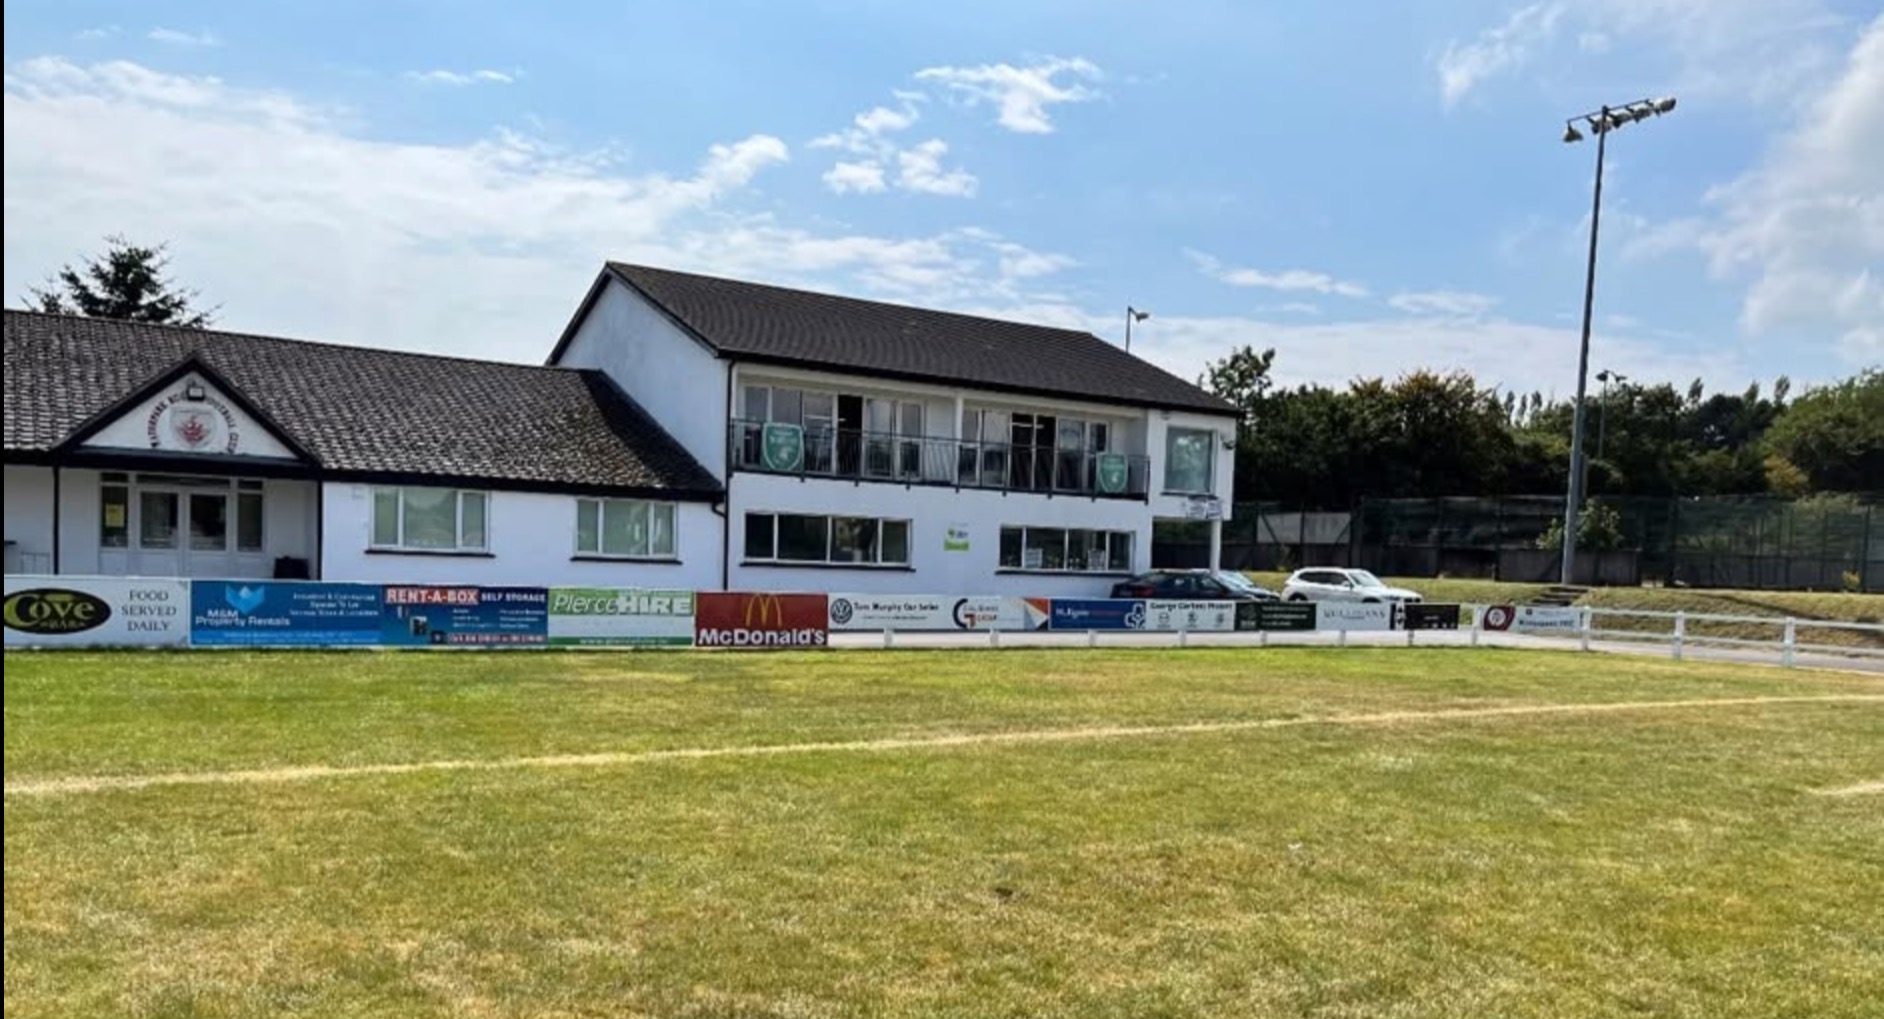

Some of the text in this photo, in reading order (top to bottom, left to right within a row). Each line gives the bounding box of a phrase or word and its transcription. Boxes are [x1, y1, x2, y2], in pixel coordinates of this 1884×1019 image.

[129, 590, 169, 601] FOOD
[387, 589, 478, 605] RENT-A-BOX
[481, 593, 545, 603] SELF STORAGE
[4, 593, 96, 627] Cove
[122, 604, 176, 616] SERVED
[207, 609, 239, 618] M&M
[873, 603, 901, 614] Murphy
[127, 620, 169, 632] DAILY
[195, 616, 291, 627] Property Rentals
[698, 627, 826, 646] McDonald's
